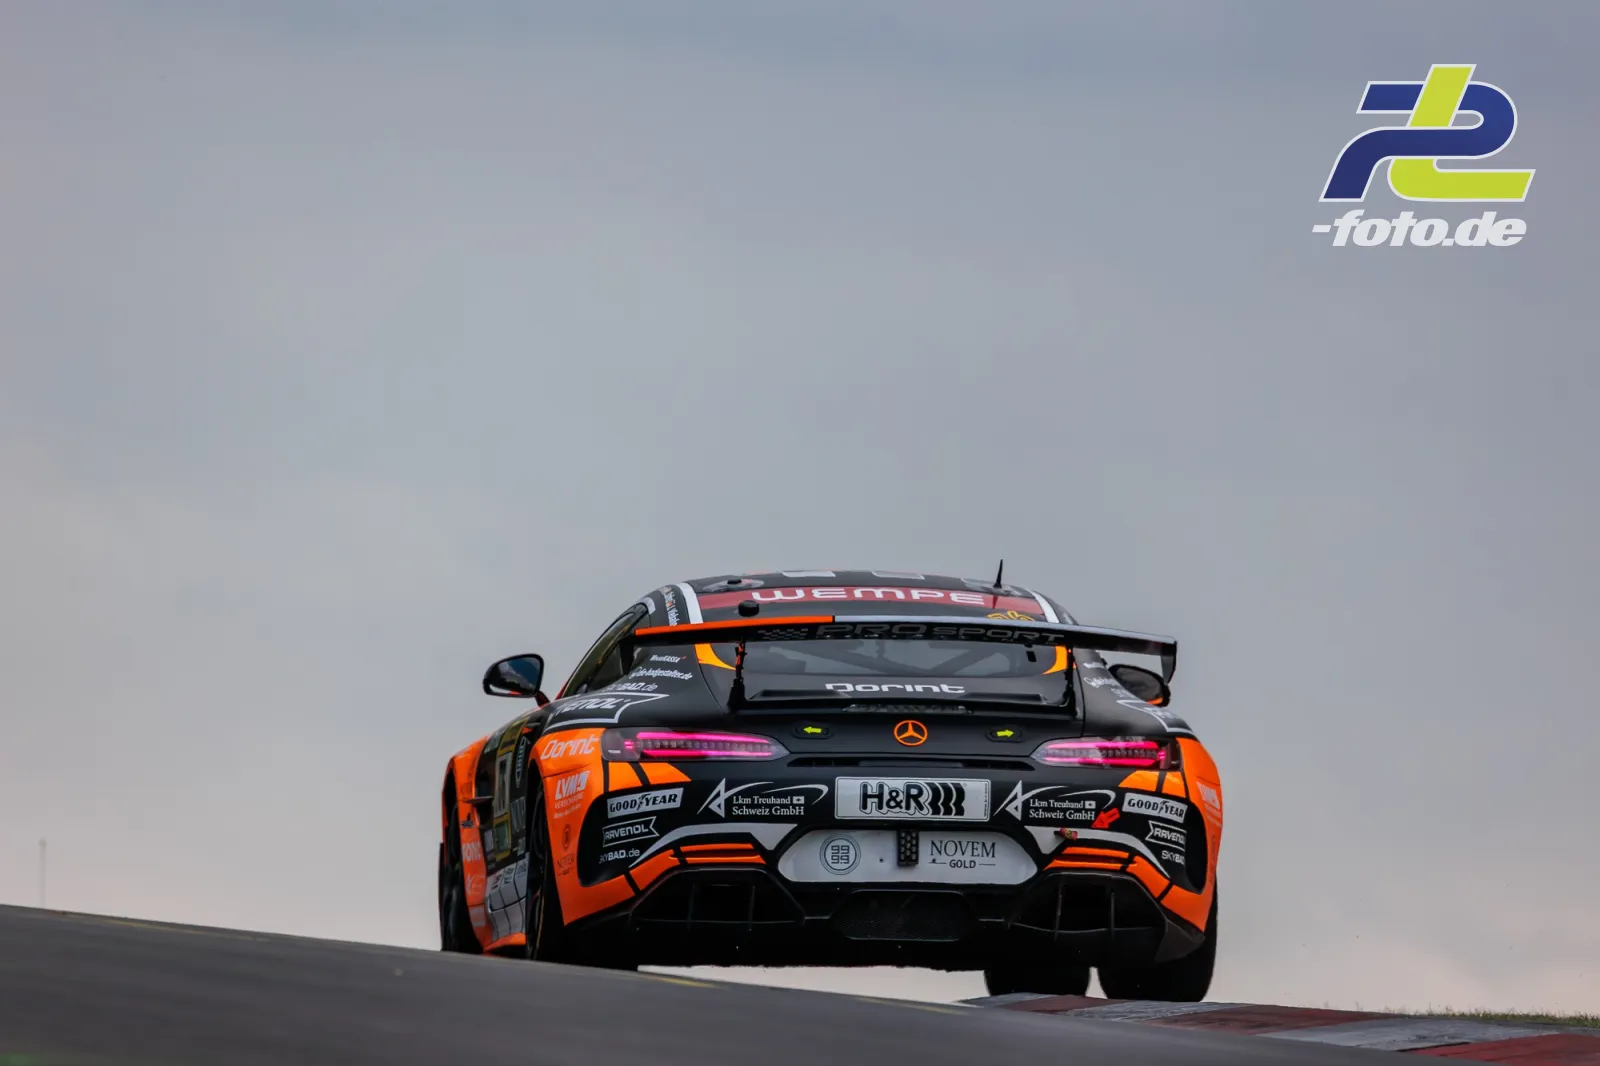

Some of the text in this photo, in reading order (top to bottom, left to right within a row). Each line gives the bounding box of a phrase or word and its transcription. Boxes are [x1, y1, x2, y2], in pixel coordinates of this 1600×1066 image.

[752, 587, 985, 605] WEMPE
[816, 623, 1065, 642] PRO SPORT
[825, 682, 966, 694] Dorint
[540, 735, 600, 760] Dorint
[732, 795, 791, 805] Lkm Treuhand
[860, 781, 929, 815] H&R
[1030, 798, 1084, 809] Lkm Treuhand
[732, 805, 805, 816] Schweiz GmbH
[1029, 808, 1095, 820] Schweiz GmbH
[604, 824, 649, 840] RAVENOL
[930, 839, 996, 859] NOVEM
[949, 859, 977, 869] GOLD
